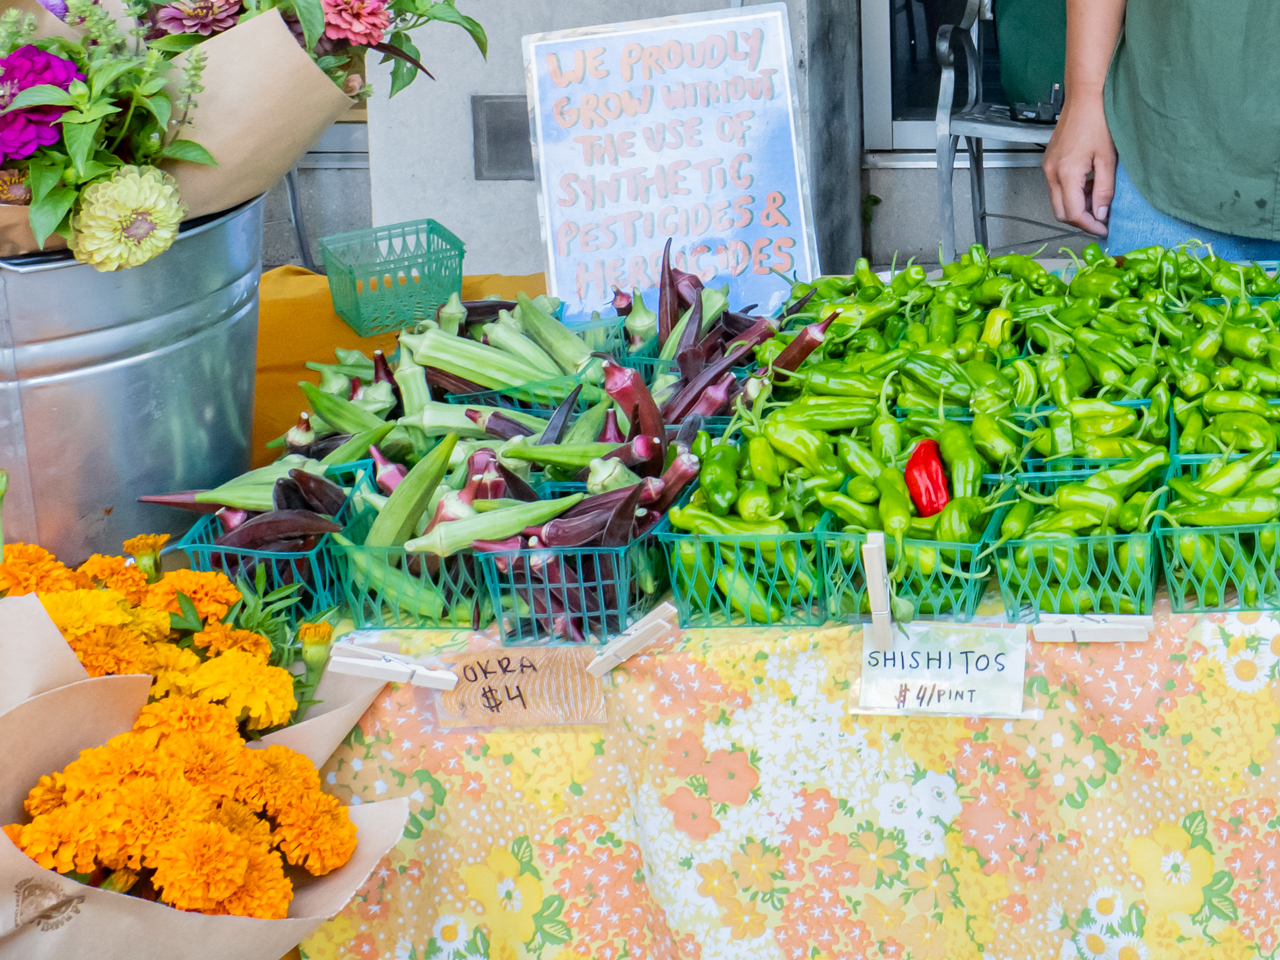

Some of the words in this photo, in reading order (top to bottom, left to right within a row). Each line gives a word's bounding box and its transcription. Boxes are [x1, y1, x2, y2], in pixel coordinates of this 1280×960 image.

[546, 47, 608, 88] WE
[619, 28, 765, 82] PROUDLY
[553, 86, 654, 129] GROW
[661, 68, 778, 110] WITHOUT
[573, 131, 637, 167] THE
[643, 116, 704, 153] USE
[716, 110, 756, 147] OF
[557, 153, 754, 212] SYNTHETIC
[556, 194, 754, 258] PESTICIDES
[759, 190, 791, 229] &
[463, 656, 538, 683] OKRA
[867, 650, 1006, 674] SHISHITOS
[481, 685, 528, 713] $4
